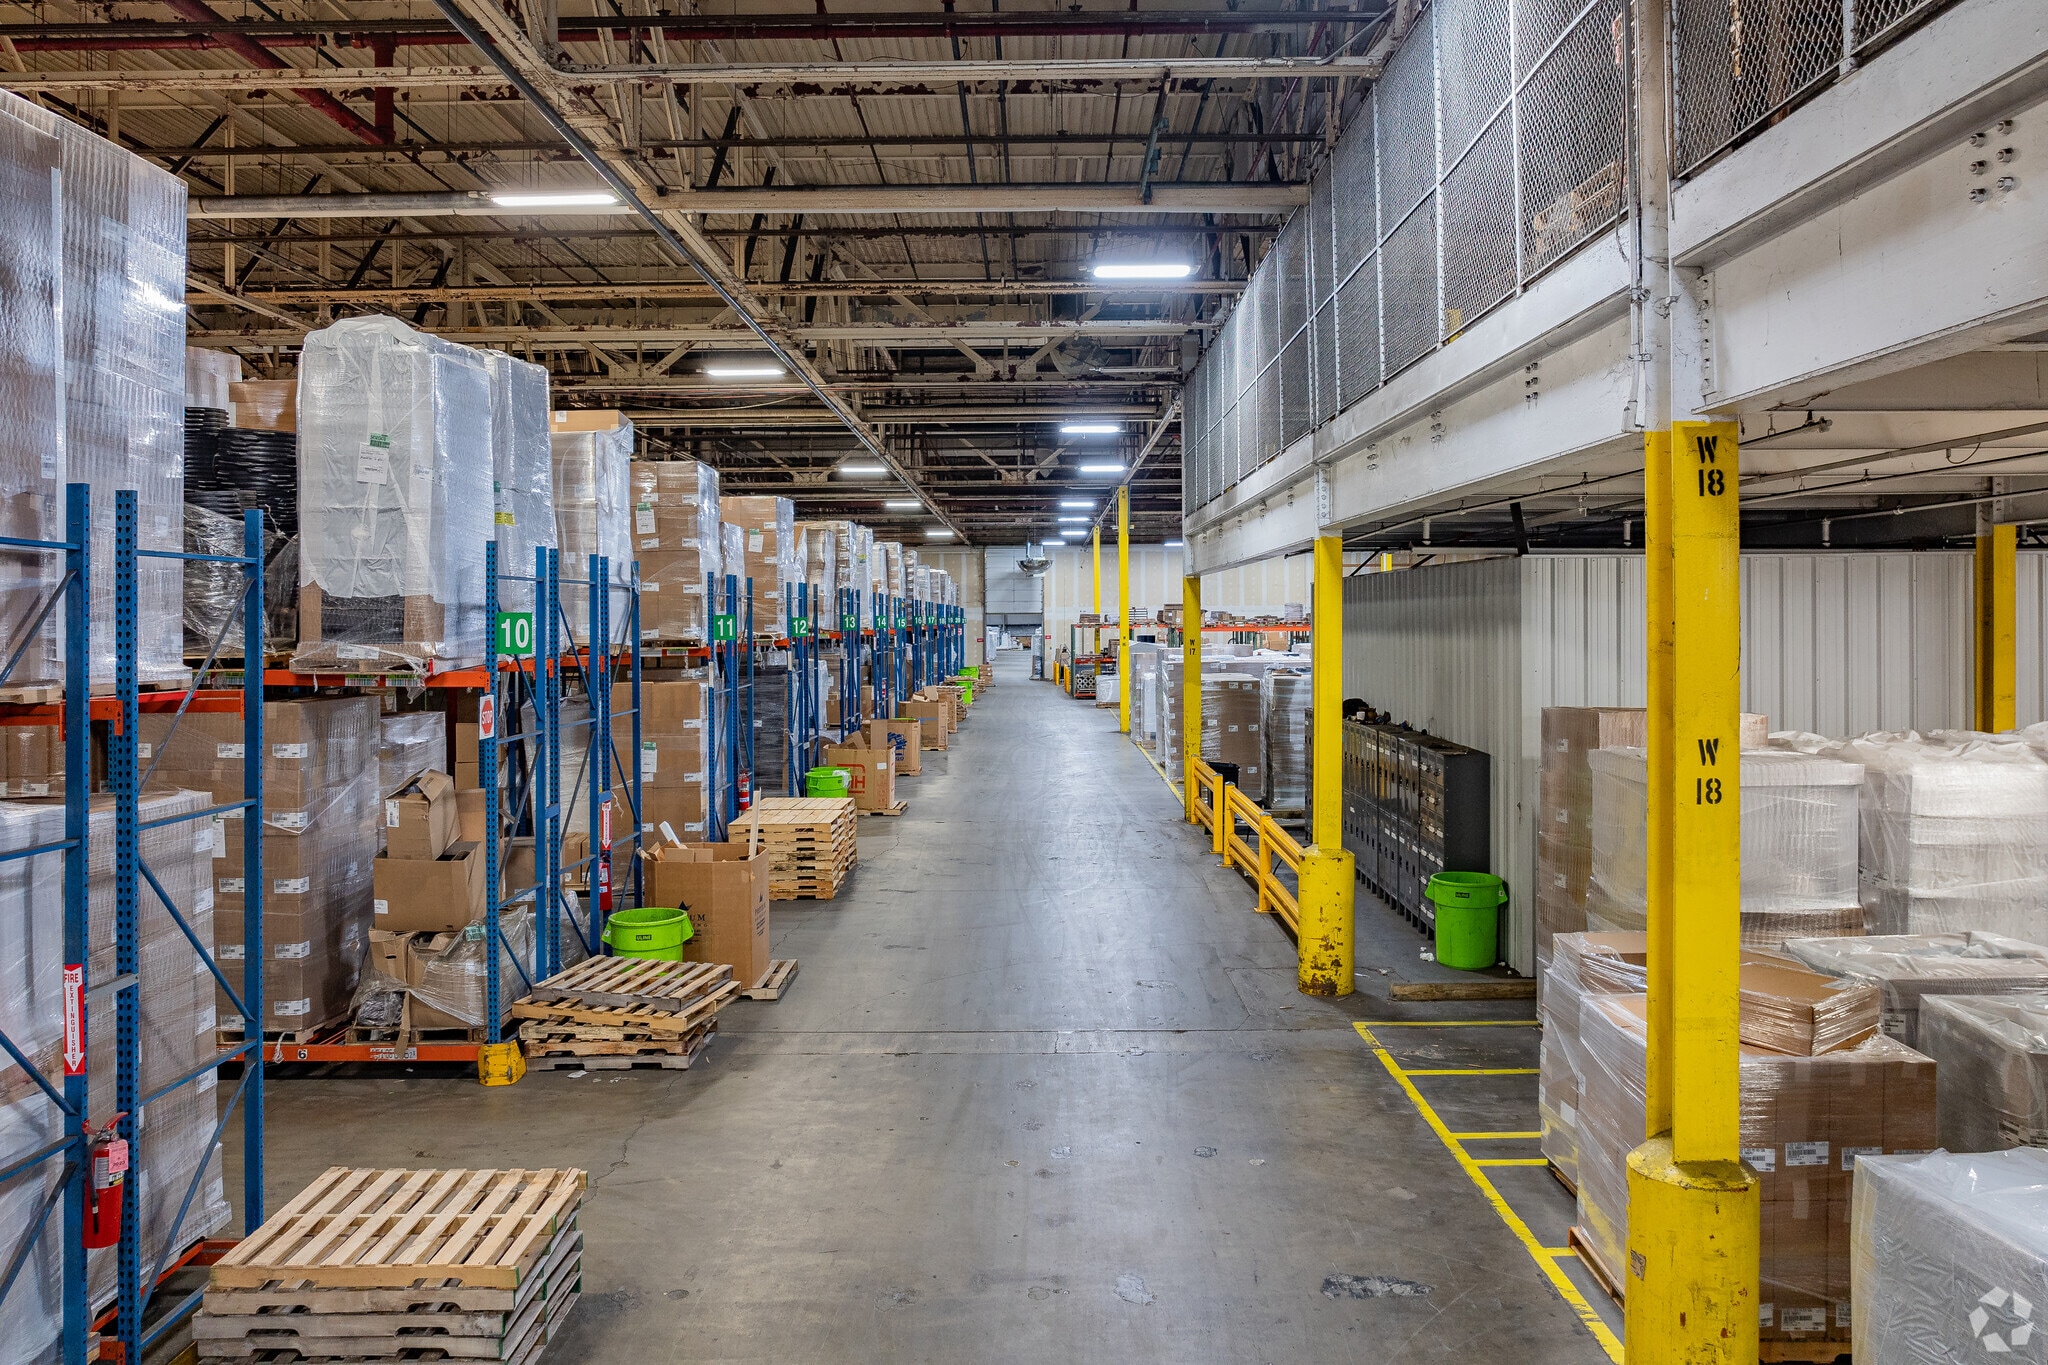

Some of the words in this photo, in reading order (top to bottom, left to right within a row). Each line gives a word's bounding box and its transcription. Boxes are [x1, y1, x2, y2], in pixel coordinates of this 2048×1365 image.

[1696, 435, 1718, 464] W
[1698, 468, 1725, 497] 18
[793, 620, 807, 634] 12
[844, 617, 856, 628] 13
[876, 617, 887, 627] 14
[897, 618, 906, 627] 15
[915, 616, 922, 624] 16
[501, 618, 529, 648] 10
[717, 618, 733, 637] 11
[1189, 638, 1196, 646] W
[1189, 647, 1196, 656] 17
[481, 710, 493, 724] STOP
[1697, 738, 1719, 767] W
[1696, 777, 1723, 805] 18
[64, 973, 79, 983] FIRE
[69, 985, 77, 1067] EXTINGUISHER
